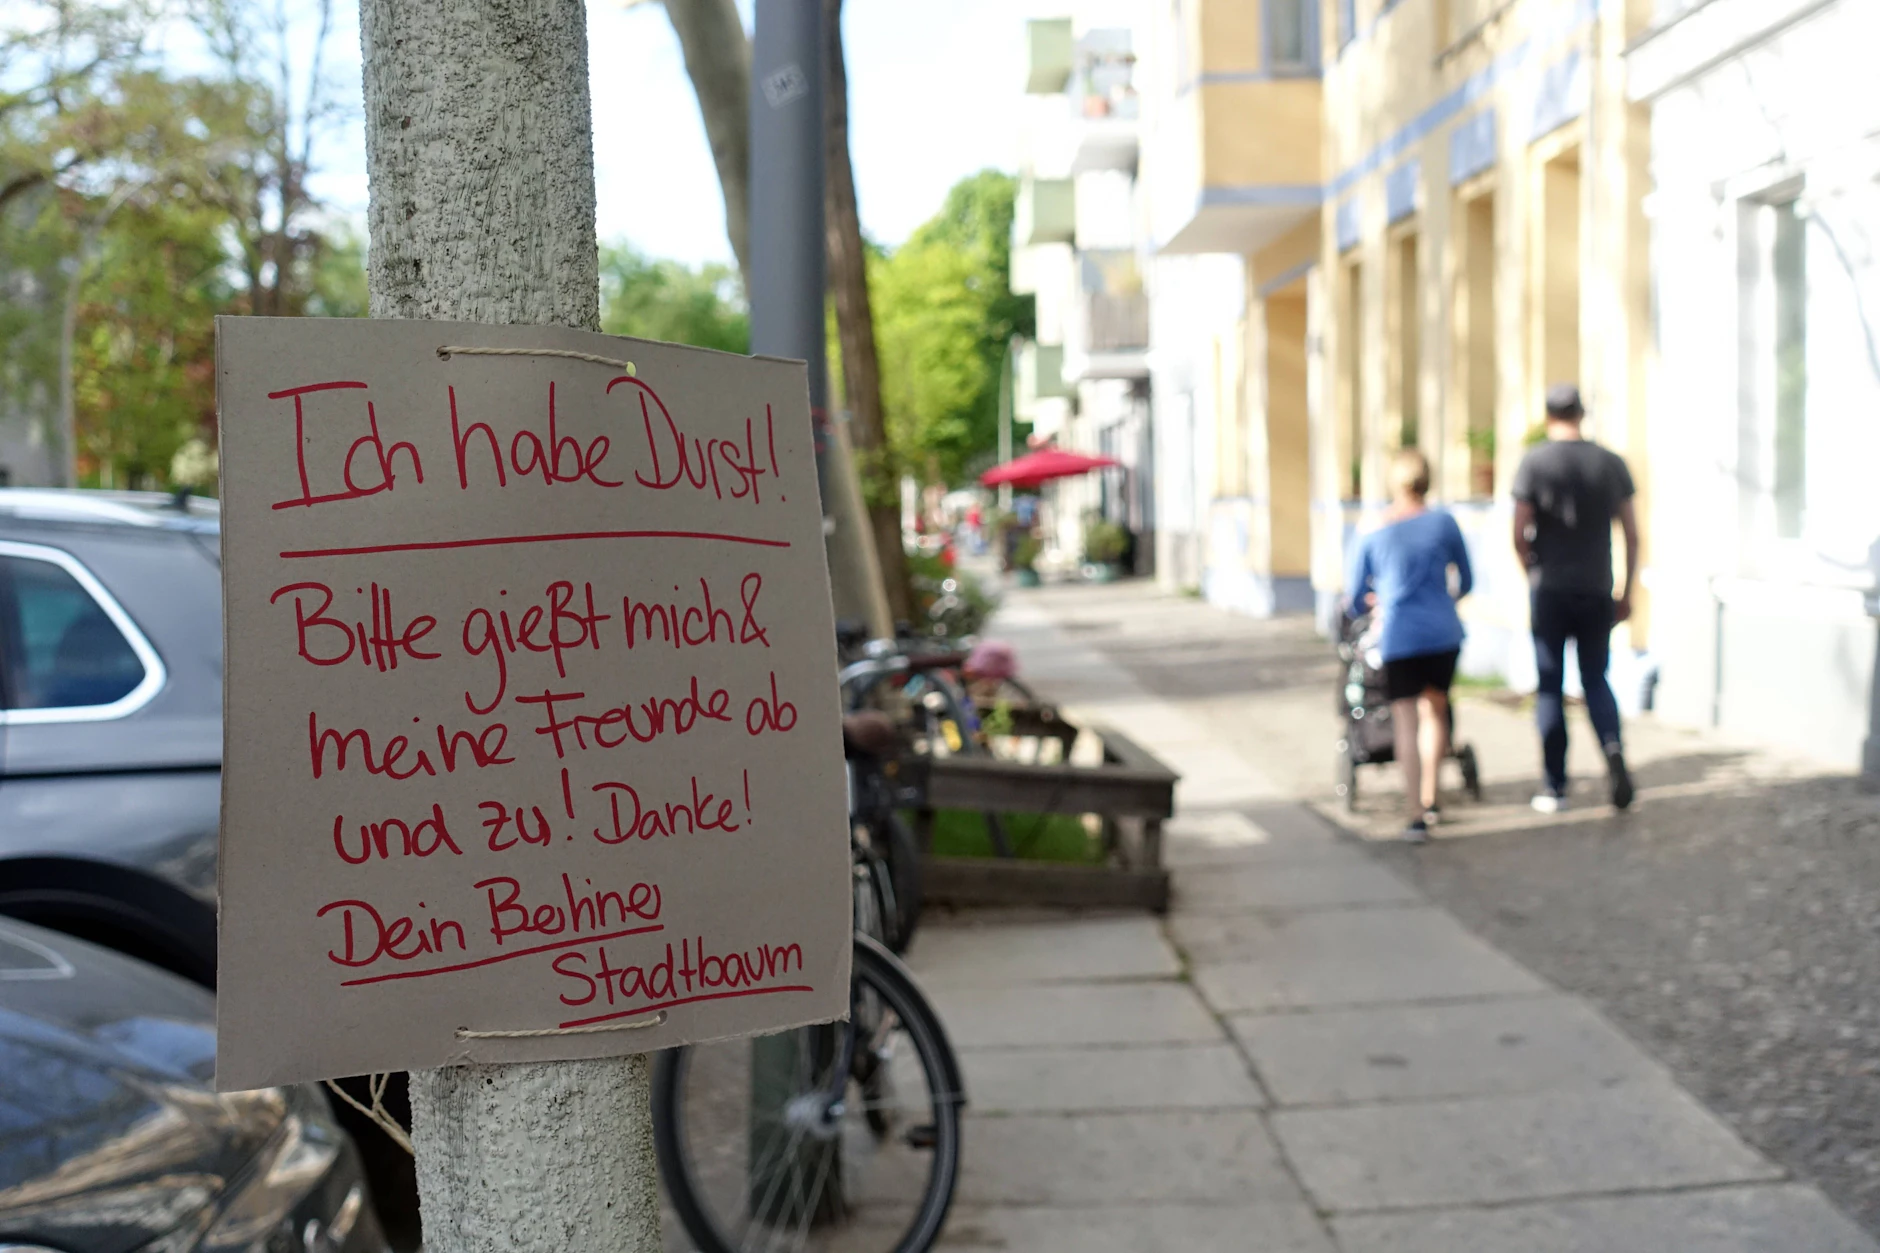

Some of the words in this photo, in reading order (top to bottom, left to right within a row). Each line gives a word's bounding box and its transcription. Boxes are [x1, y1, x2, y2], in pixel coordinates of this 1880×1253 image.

[267, 380, 424, 510] Ich
[447, 380, 623, 490] habe
[606, 375, 787, 505] Durst!
[270, 581, 442, 673] Bitte
[462, 579, 612, 715] gießt
[310, 711, 516, 780] meine
[514, 676, 732, 759] Freunde
[745, 672, 798, 737] ab
[333, 803, 463, 865] und
[477, 767, 576, 853] zu!
[592, 768, 752, 845] Danke!
[316, 899, 466, 967] Dein
[550, 936, 804, 1007] Stadtbaum
